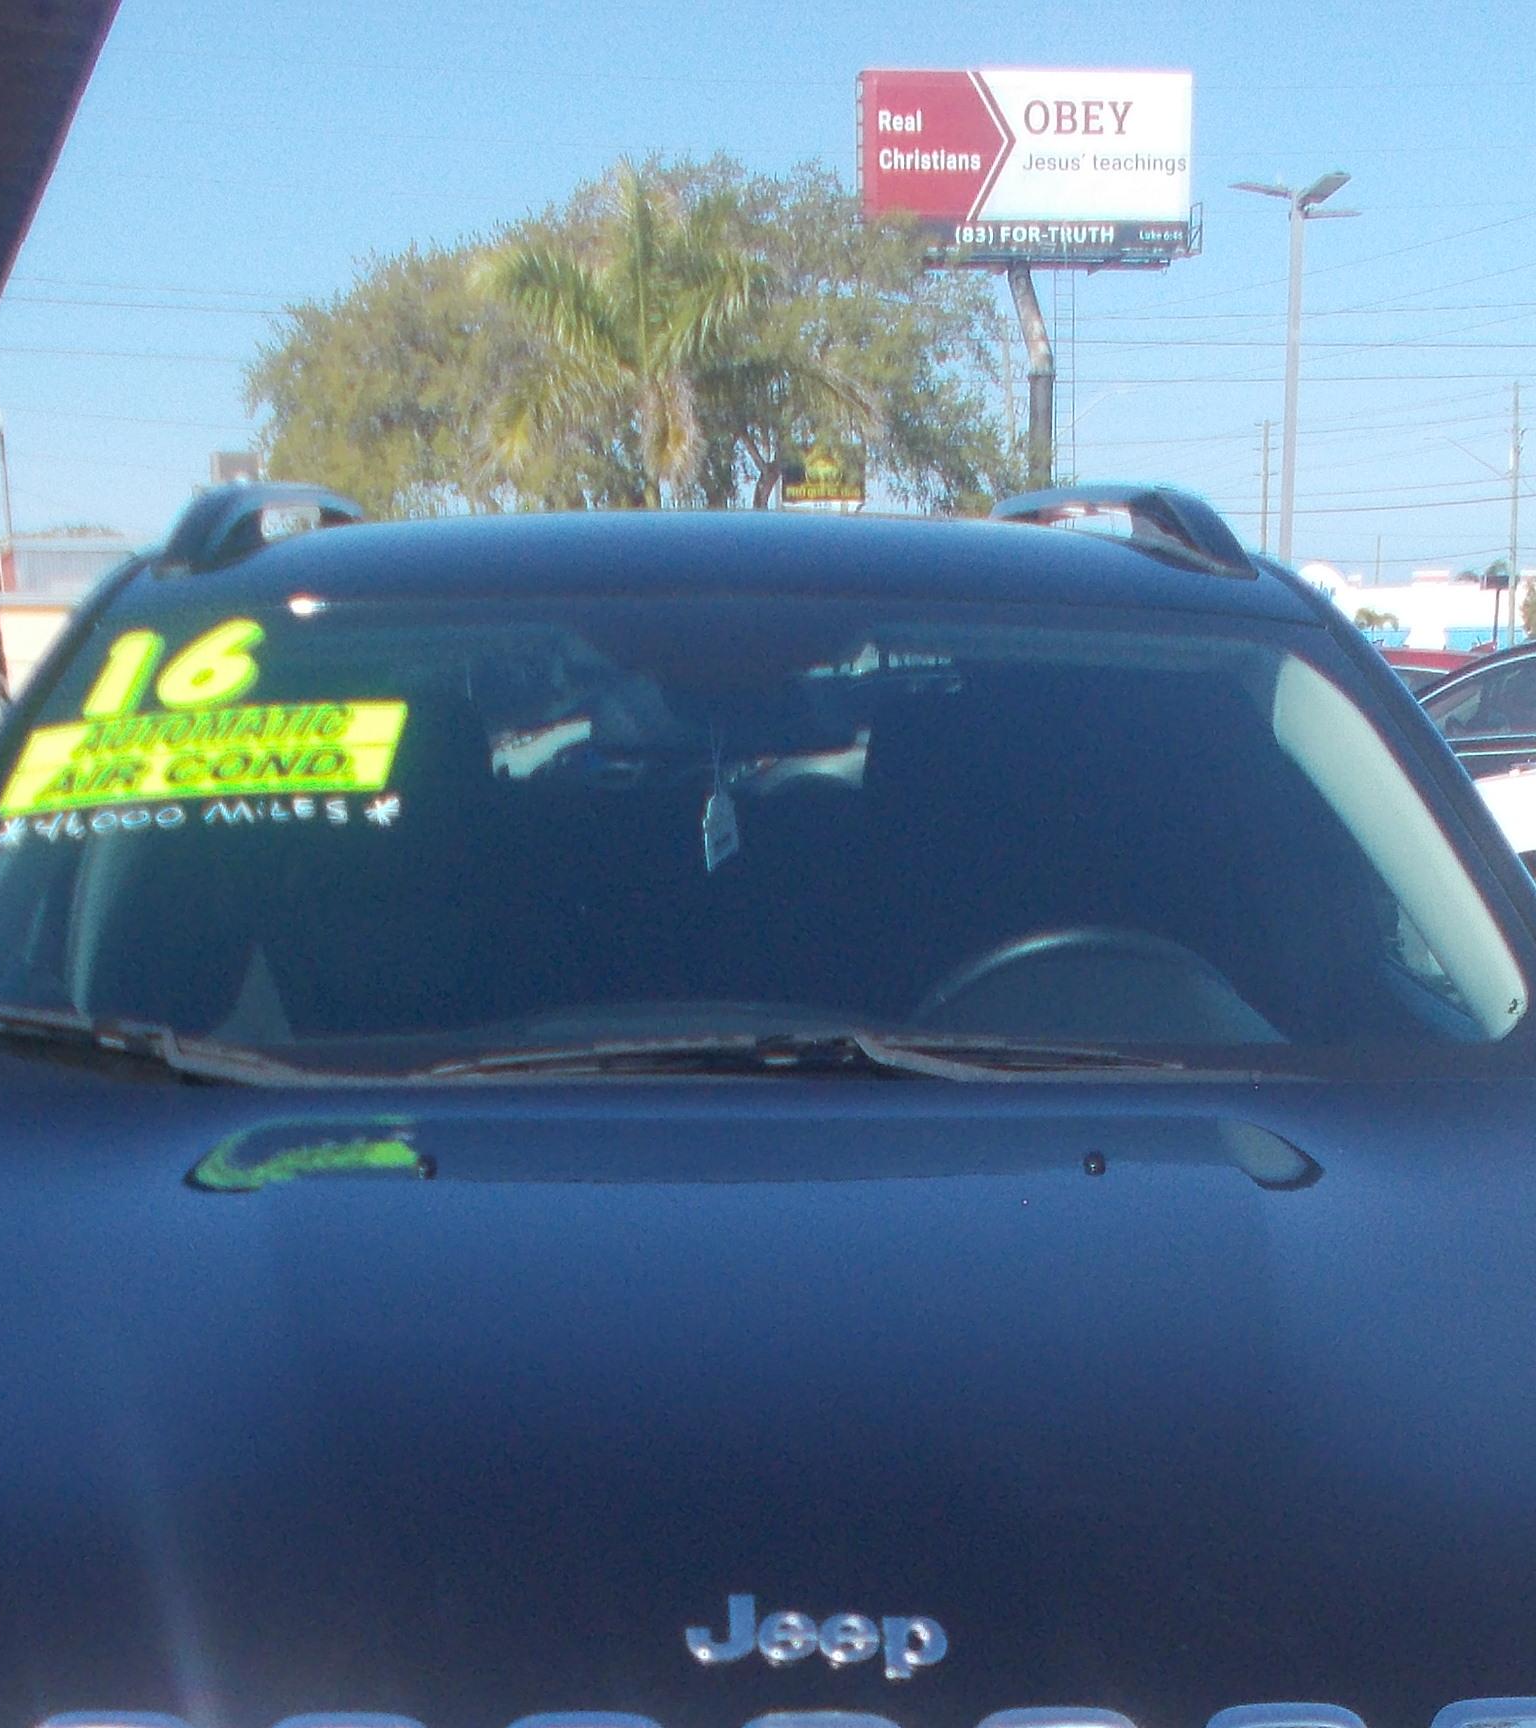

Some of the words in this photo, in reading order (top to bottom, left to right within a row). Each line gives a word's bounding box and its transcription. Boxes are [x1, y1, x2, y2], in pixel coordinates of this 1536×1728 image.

[878, 110, 922, 132] Real
[1023, 100, 1133, 136] OBEY
[879, 148, 981, 171] Christians
[1093, 153, 1186, 176] teachings
[955, 225, 994, 245] (83)
[1000, 226, 1114, 243] FOR-TRUTH
[1139, 229, 1161, 241] Luke
[83, 618, 264, 720] 16
[71, 703, 354, 755] AUTOMATIC
[36, 754, 150, 800] AIR
[162, 747, 352, 786] COND
[202, 797, 348, 827] MILES
[685, 1594, 948, 1680] Jeep
